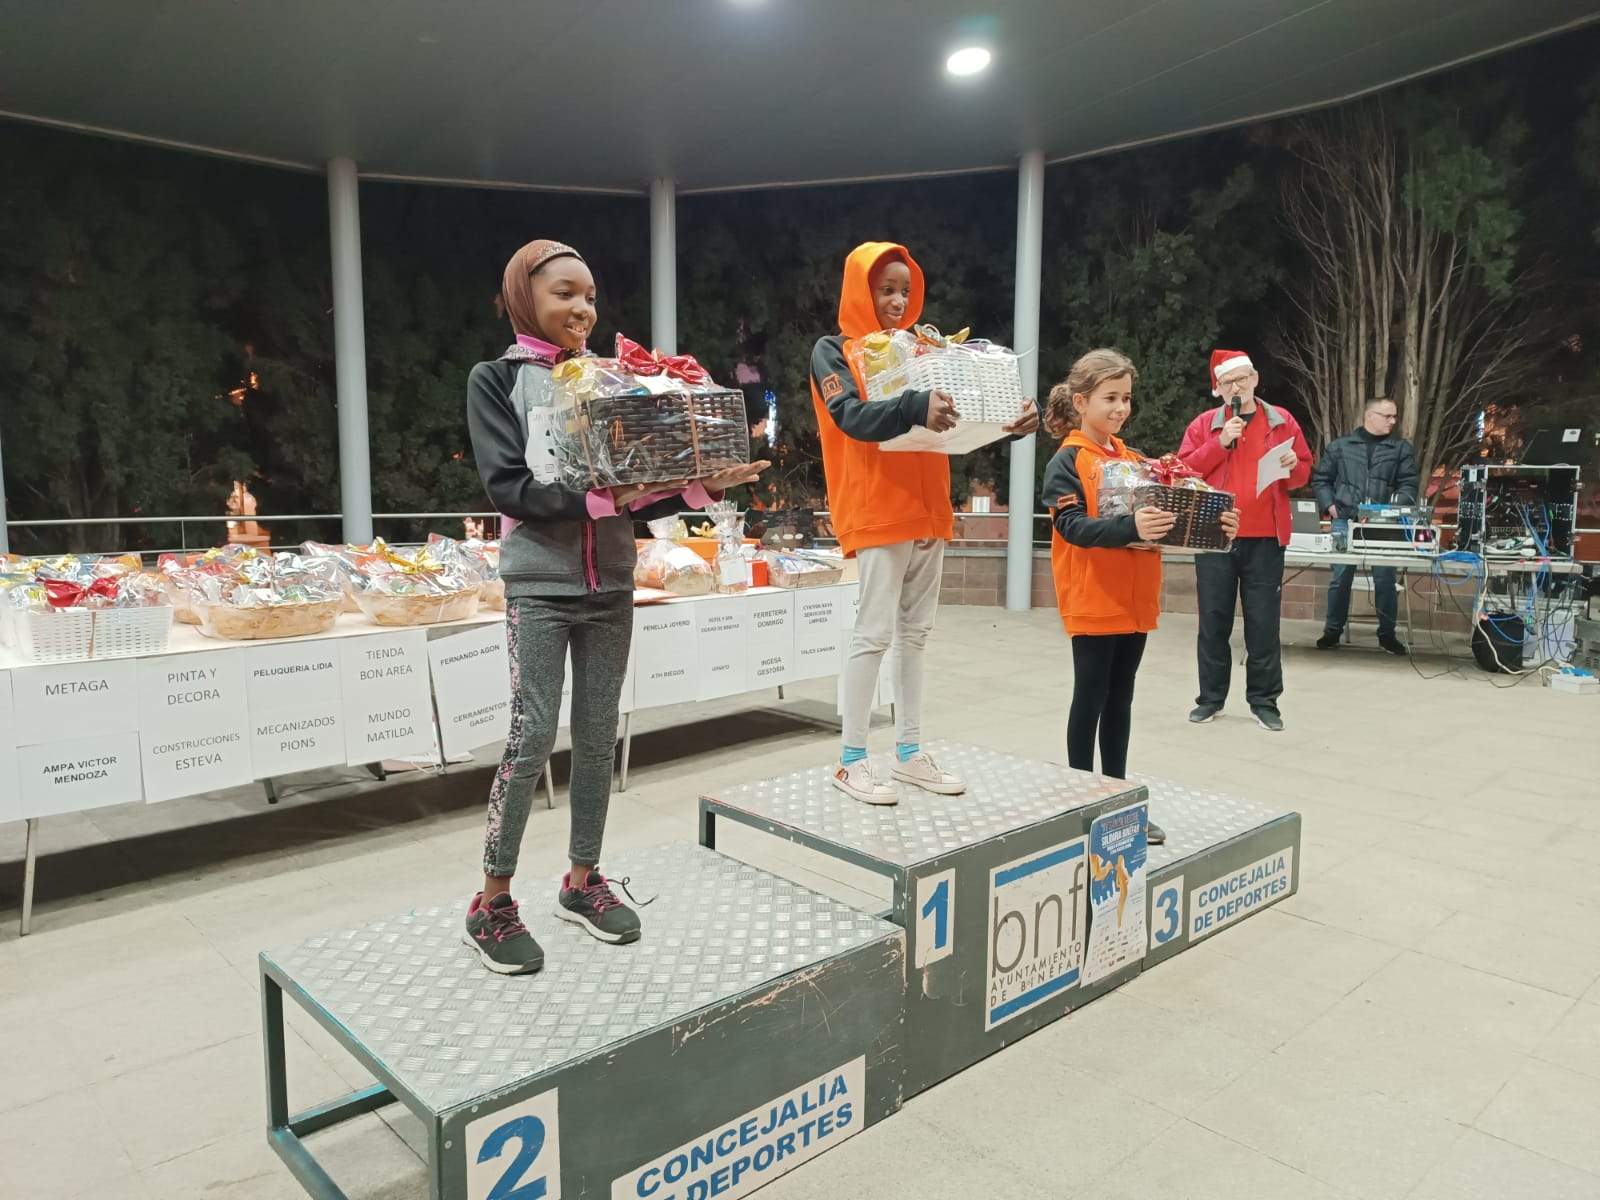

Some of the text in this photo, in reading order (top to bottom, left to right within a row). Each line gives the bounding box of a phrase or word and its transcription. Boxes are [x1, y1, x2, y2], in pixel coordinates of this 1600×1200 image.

[754, 608, 787, 619] FERRETERIA
[757, 618, 784, 628] DOMINGO
[366, 646, 405, 660] TIENDA
[440, 644, 501, 666] FERNANDO AGON
[760, 656, 782, 666] INGESA
[167, 668, 218, 684] PINTA Y
[254, 661, 333, 678] PELUQUERIA LIDIA
[360, 664, 413, 681] BON AREA
[664, 669, 685, 677] RIEGOS
[757, 665, 785, 676] GESTORIA
[45, 679, 109, 697] METAGA
[167, 687, 221, 706] DECORA
[368, 708, 411, 724] MUNDO
[453, 701, 507, 723] CERRAMIENTOS
[469, 714, 495, 727] GASCO
[257, 715, 336, 736] MECANIZADOS
[367, 726, 415, 743] MATILDA
[152, 731, 241, 755] CONSTRUCCIONES
[280, 738, 316, 752] PIONS
[43, 755, 118, 775] AMPA VICTOR
[175, 753, 223, 771] ESTEVA
[54, 768, 109, 785] MENDOZA
[1197, 856, 1286, 908] CONCEJALIA
[1194, 875, 1288, 934] DE DEPORTES
[921, 880, 949, 950] 1
[992, 862, 1085, 978] bnf
[1154, 887, 1180, 944] 3
[990, 941, 1083, 994] AYUNTAMIENTO
[990, 988, 1008, 1008] DE
[636, 1074, 849, 1198] CONCEJALIA
[476, 1115, 548, 1200] 2
[686, 1101, 853, 1200] DEPORTES
